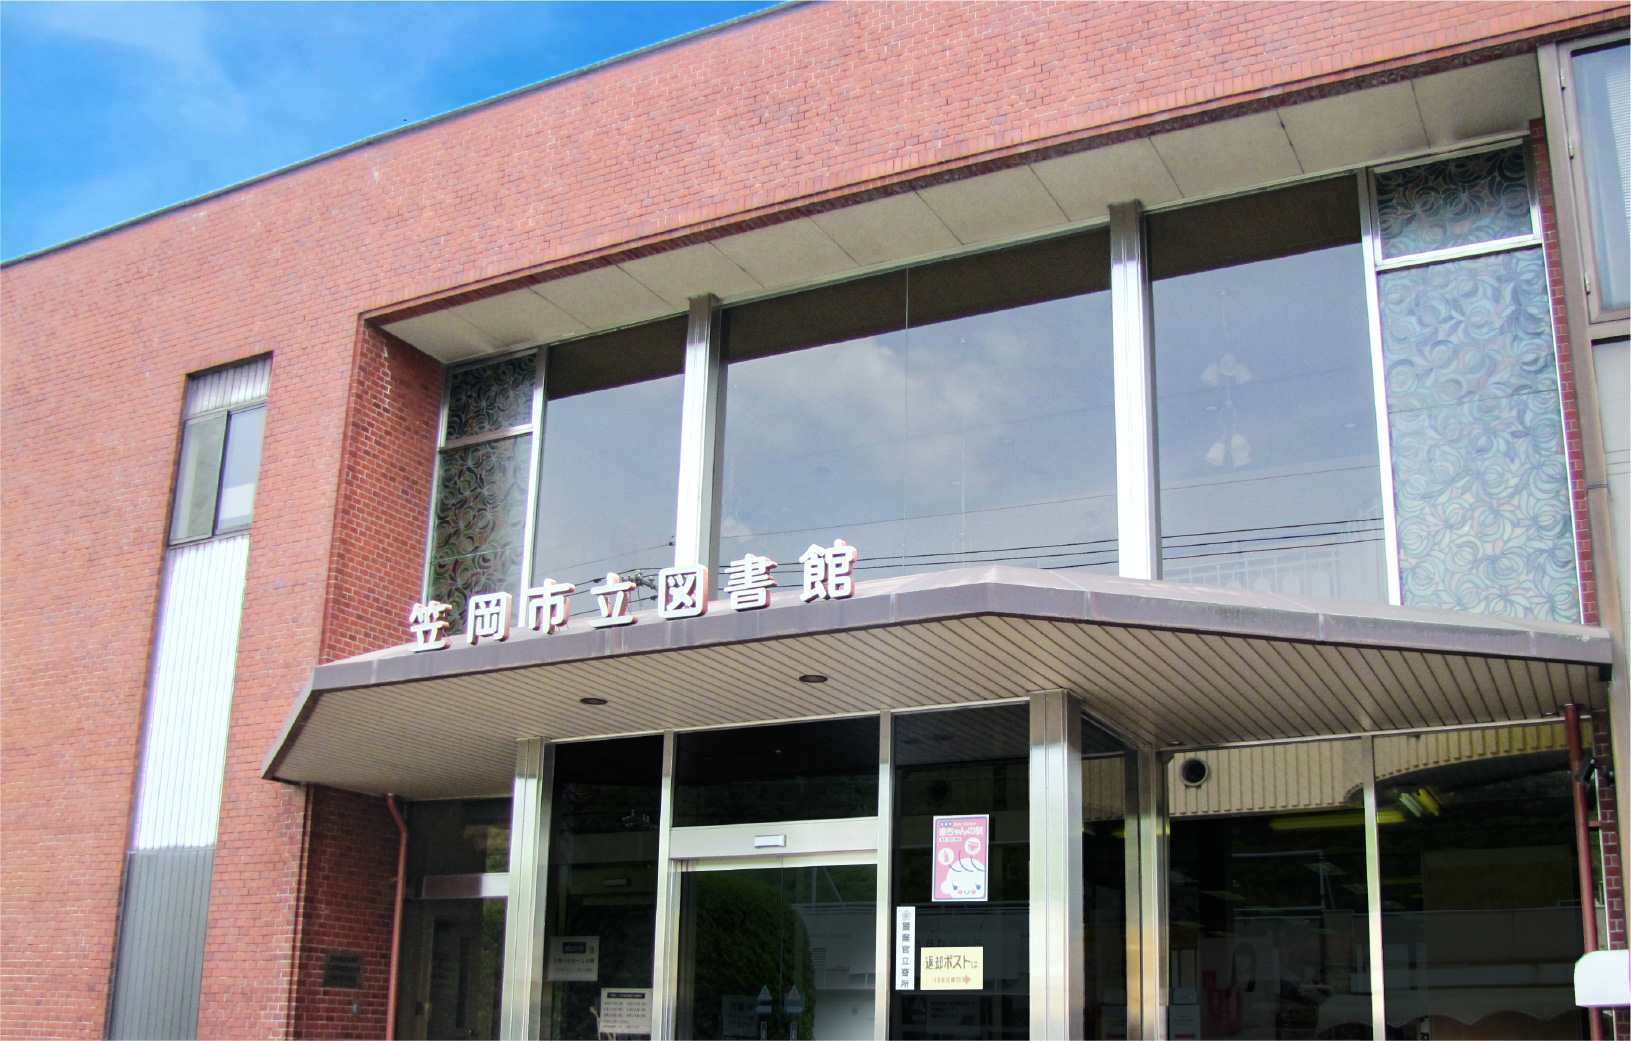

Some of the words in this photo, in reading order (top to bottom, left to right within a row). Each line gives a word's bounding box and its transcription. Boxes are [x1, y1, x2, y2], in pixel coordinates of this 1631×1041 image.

[409, 539, 857, 652] 笠岡市立図書館
[901, 921, 911, 988] 警察官立寄所
[925, 954, 979, 970] 返却ポストは
